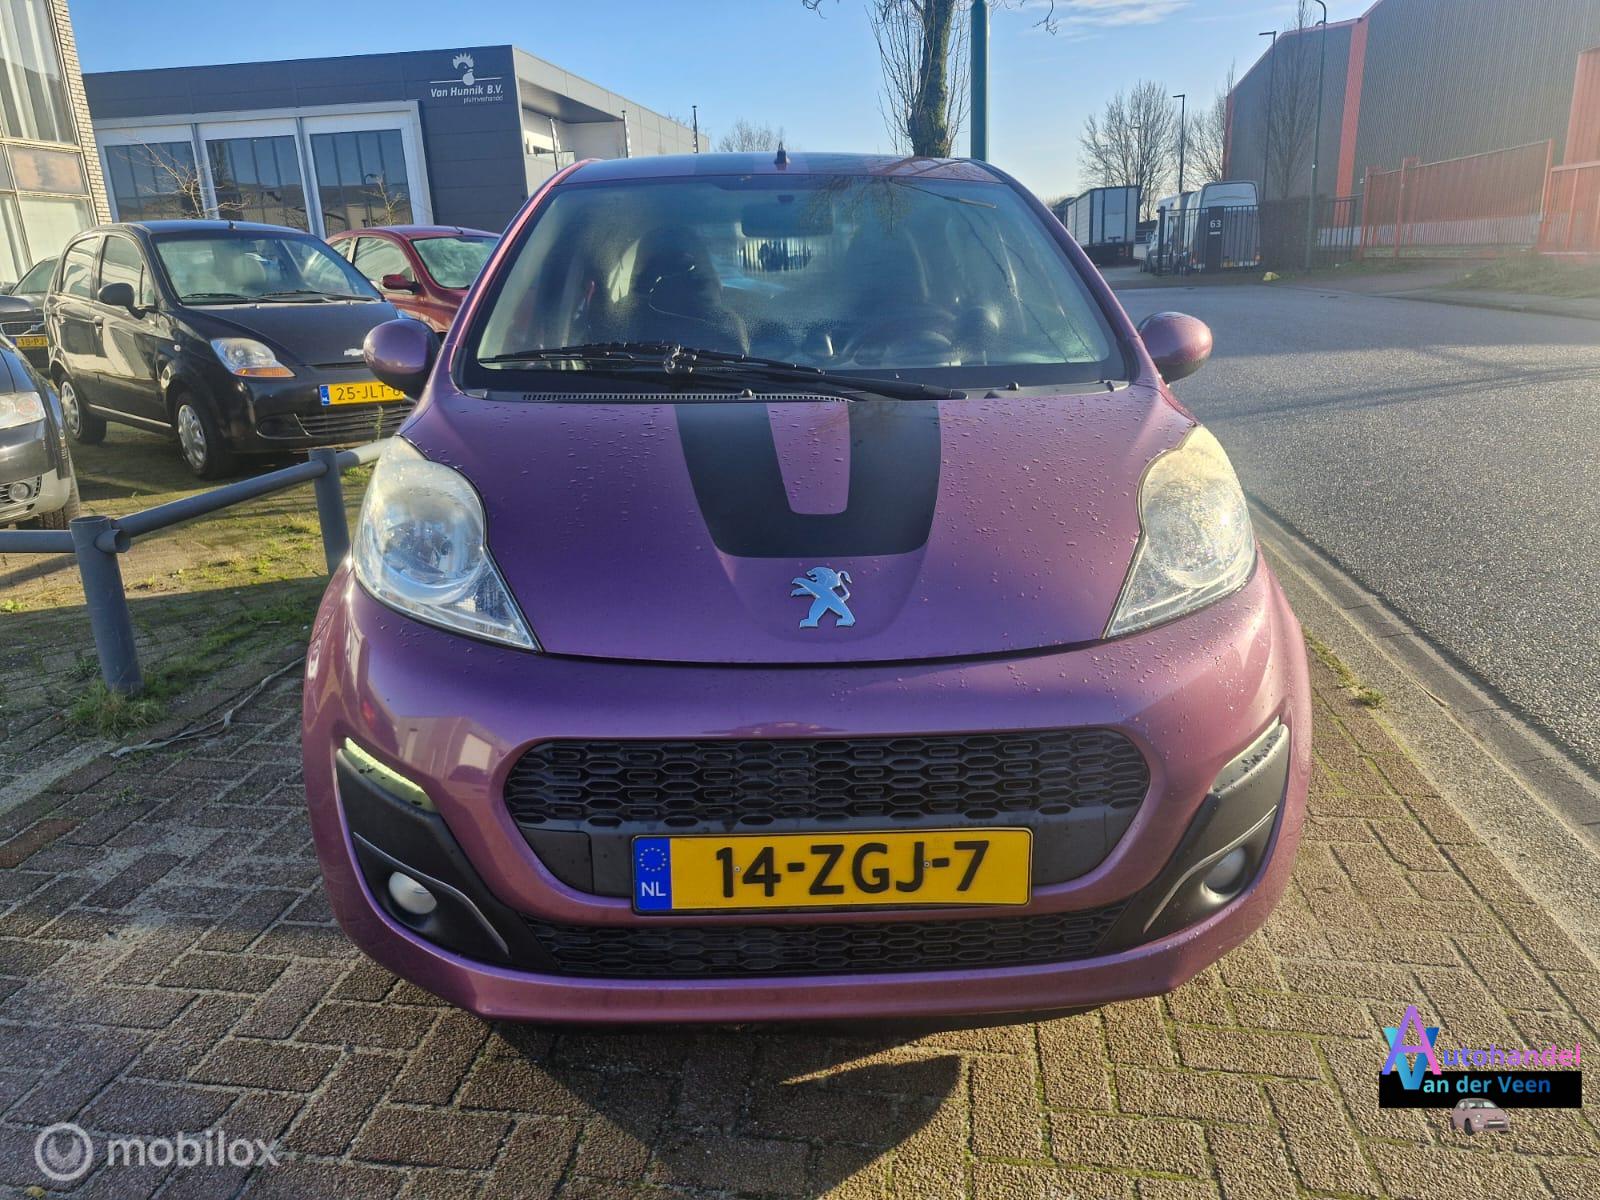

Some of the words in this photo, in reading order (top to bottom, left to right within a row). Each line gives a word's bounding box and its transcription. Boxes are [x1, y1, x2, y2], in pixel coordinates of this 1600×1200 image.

[430, 88, 448, 97] Van
[450, 85, 483, 96] Hunnik
[487, 84, 503, 95] B.V.
[1210, 219, 1222, 228] 63
[716, 840, 990, 898] 14-ZGJ-7
[641, 881, 667, 897] NL
